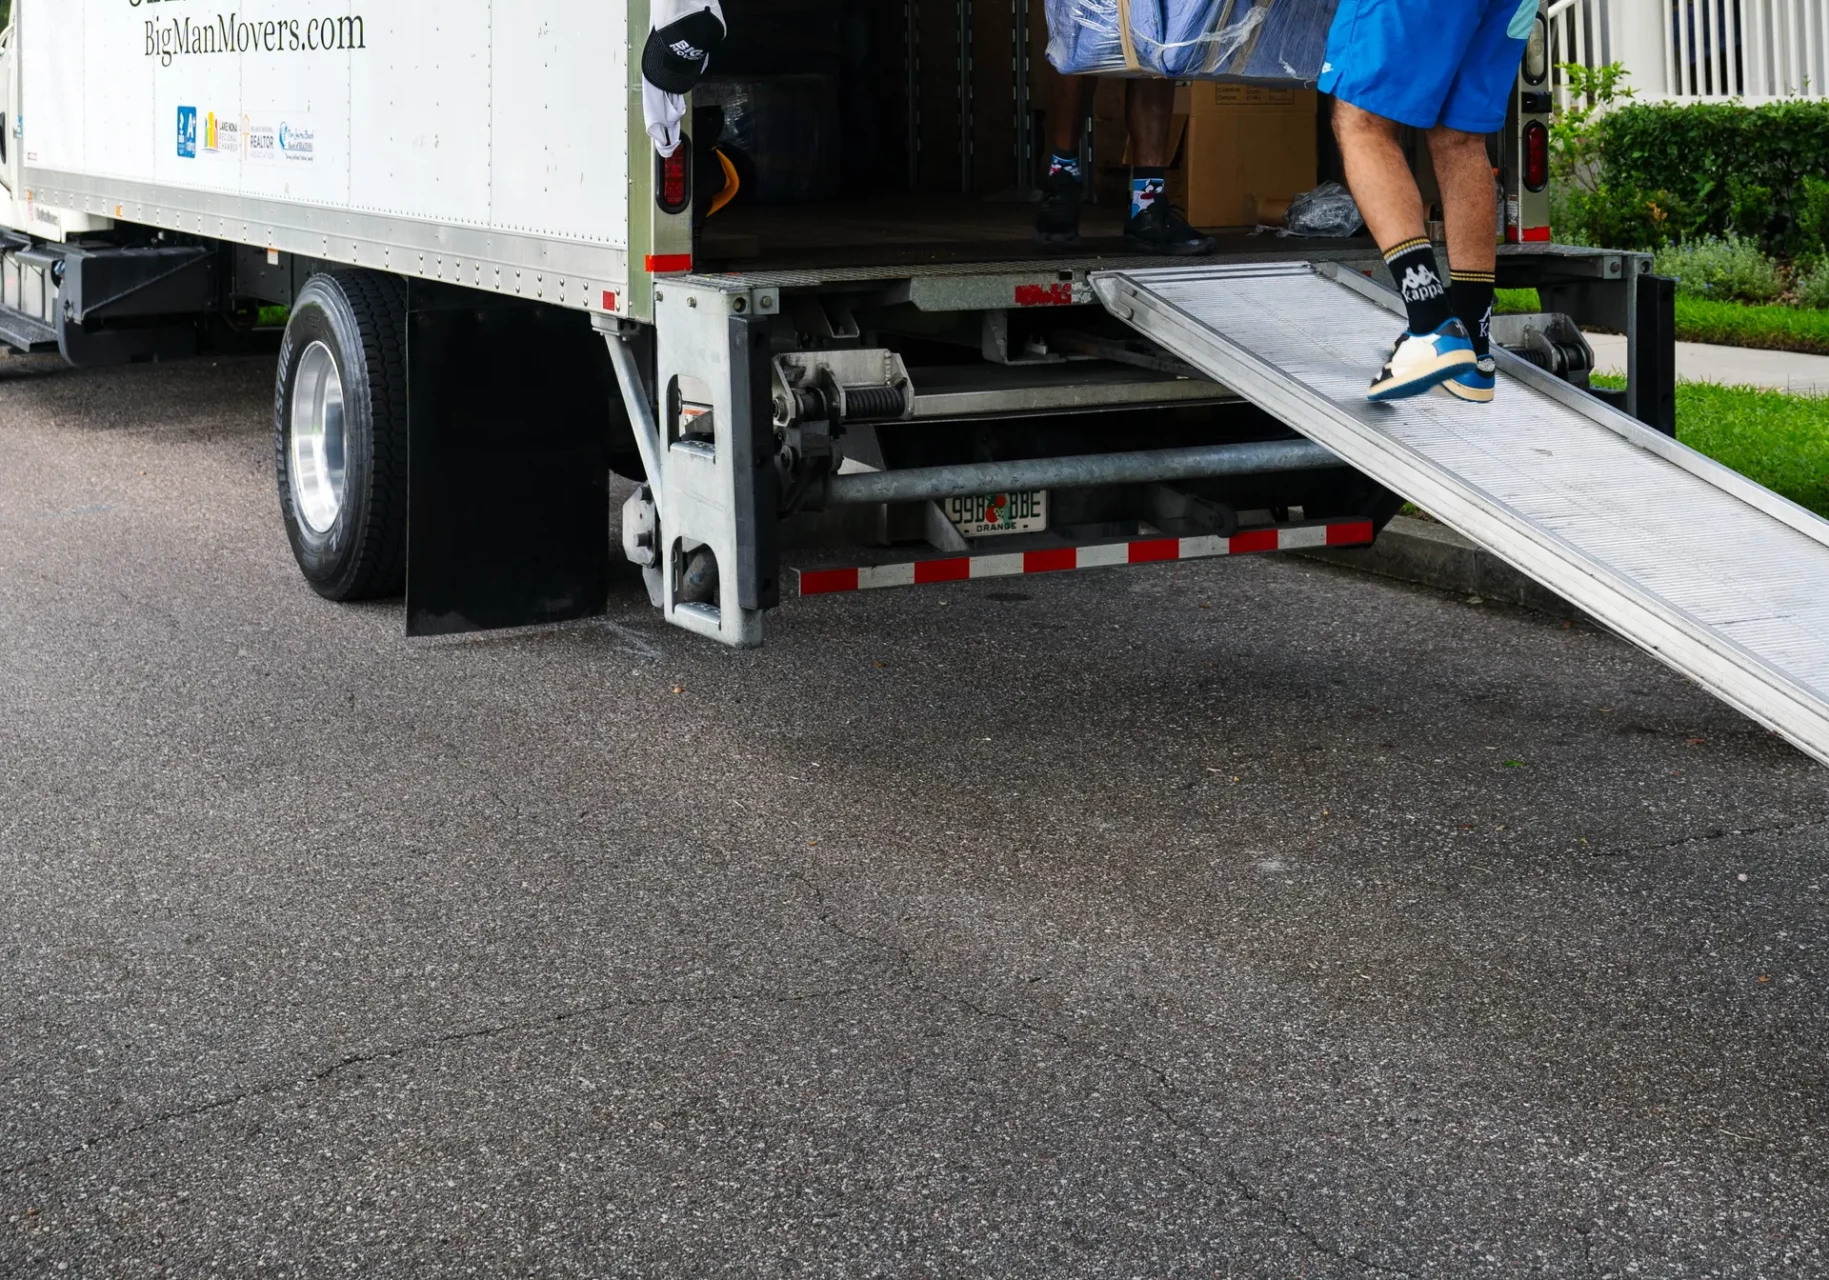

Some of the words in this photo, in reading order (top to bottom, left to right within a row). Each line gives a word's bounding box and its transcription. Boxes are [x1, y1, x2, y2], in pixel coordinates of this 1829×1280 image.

[144, 12, 366, 68] BigManMovers.com
[250, 134, 275, 148] REALTOR
[976, 522, 1017, 533] ORANGE
